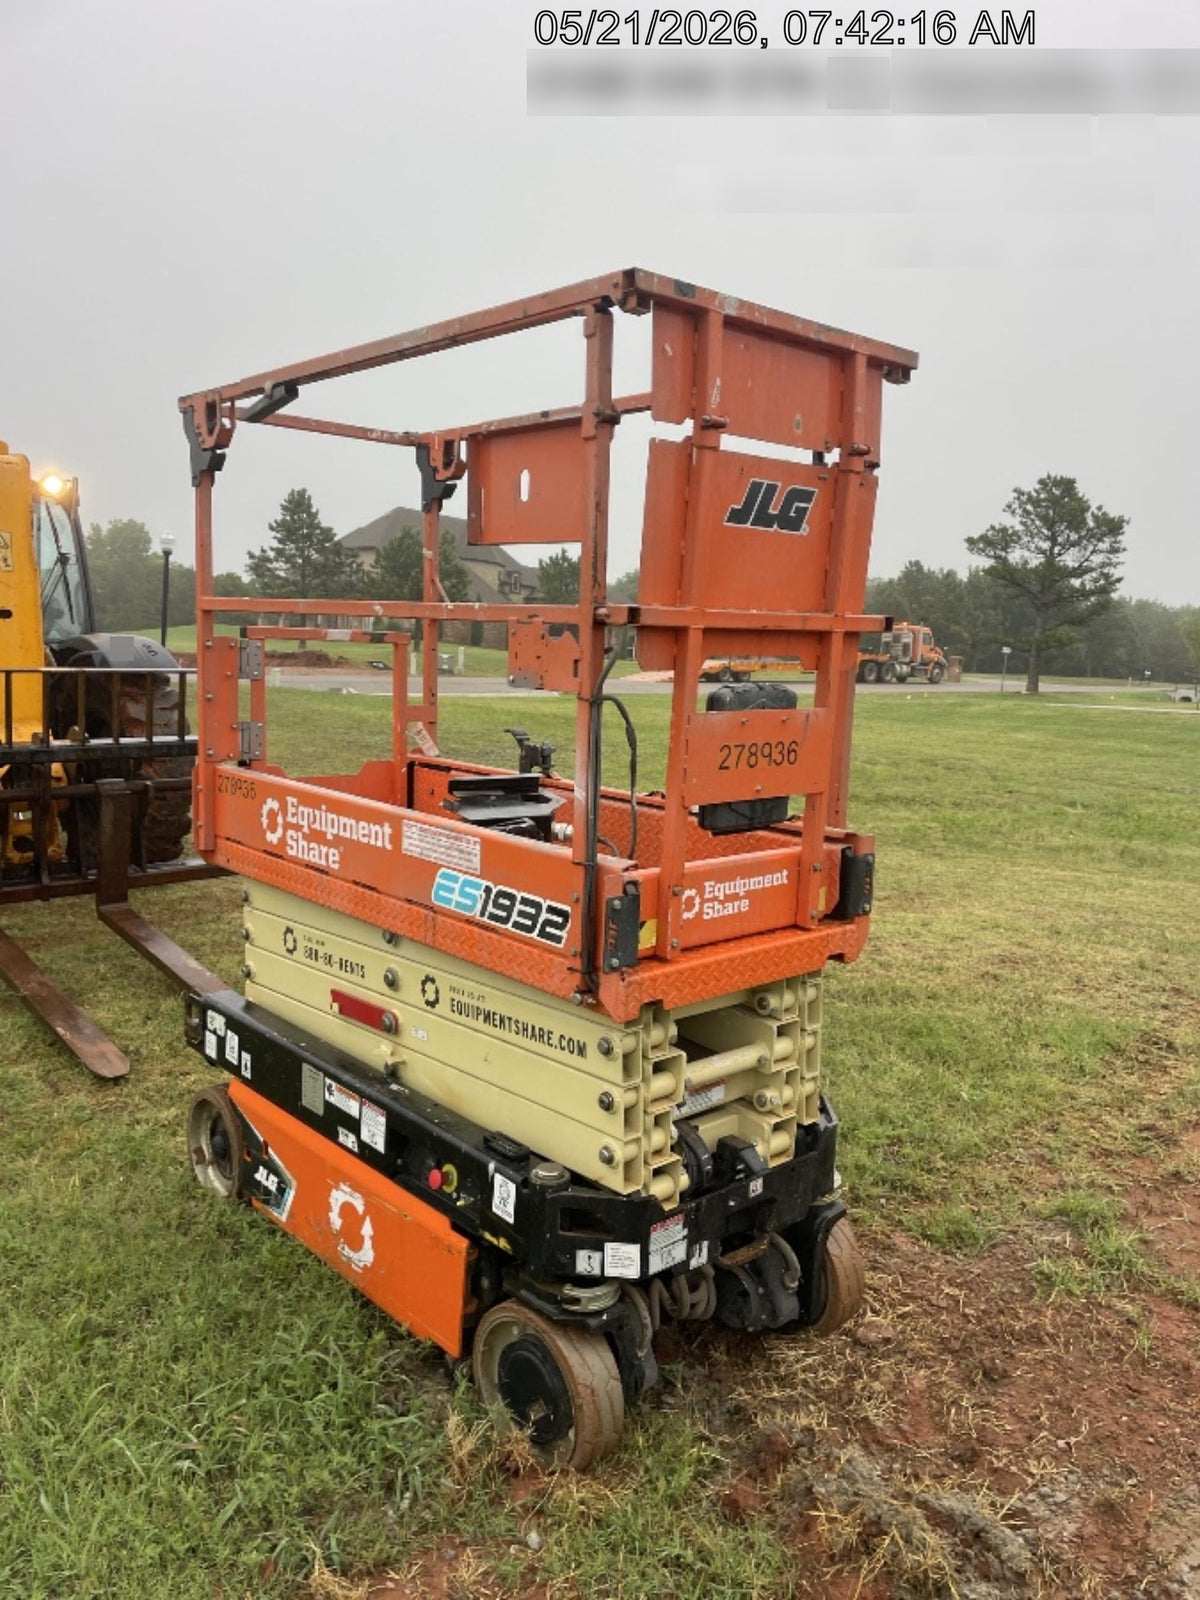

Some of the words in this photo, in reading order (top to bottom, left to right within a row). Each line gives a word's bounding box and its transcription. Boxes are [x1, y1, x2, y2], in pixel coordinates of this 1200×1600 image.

[723, 478, 818, 535] JLG
[718, 740, 799, 770] 278936
[285, 796, 392, 850] Equipment
[285, 829, 340, 870] Share
[432, 867, 571, 948] ES1932
[703, 869, 788, 899] Equipment
[703, 897, 750, 920] Share
[450, 998, 588, 1060] EQUIPMENTSHARE.COM
